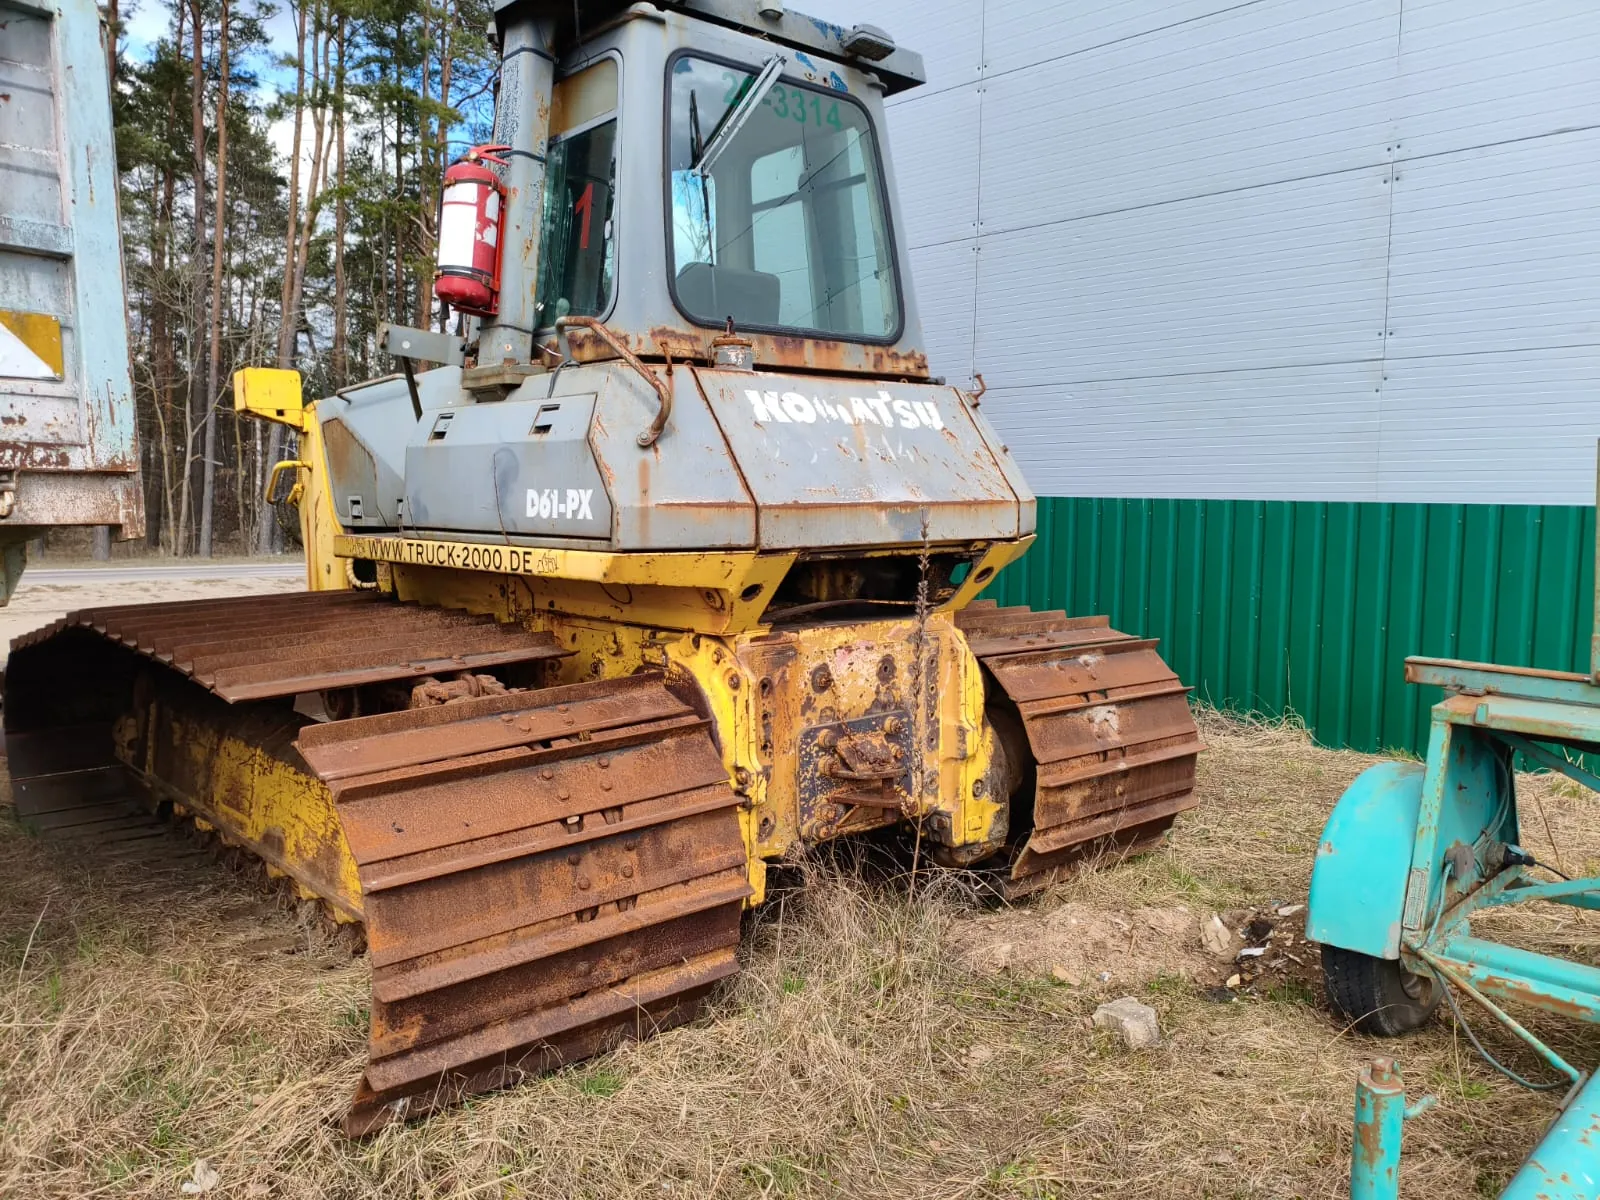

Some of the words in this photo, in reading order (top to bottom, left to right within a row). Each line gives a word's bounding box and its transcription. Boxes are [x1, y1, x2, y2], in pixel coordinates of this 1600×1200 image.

[575, 182, 593, 249] 1
[525, 488, 594, 520] D61-PX
[367, 539, 533, 574] WWW.TRUCK-2000.DE
